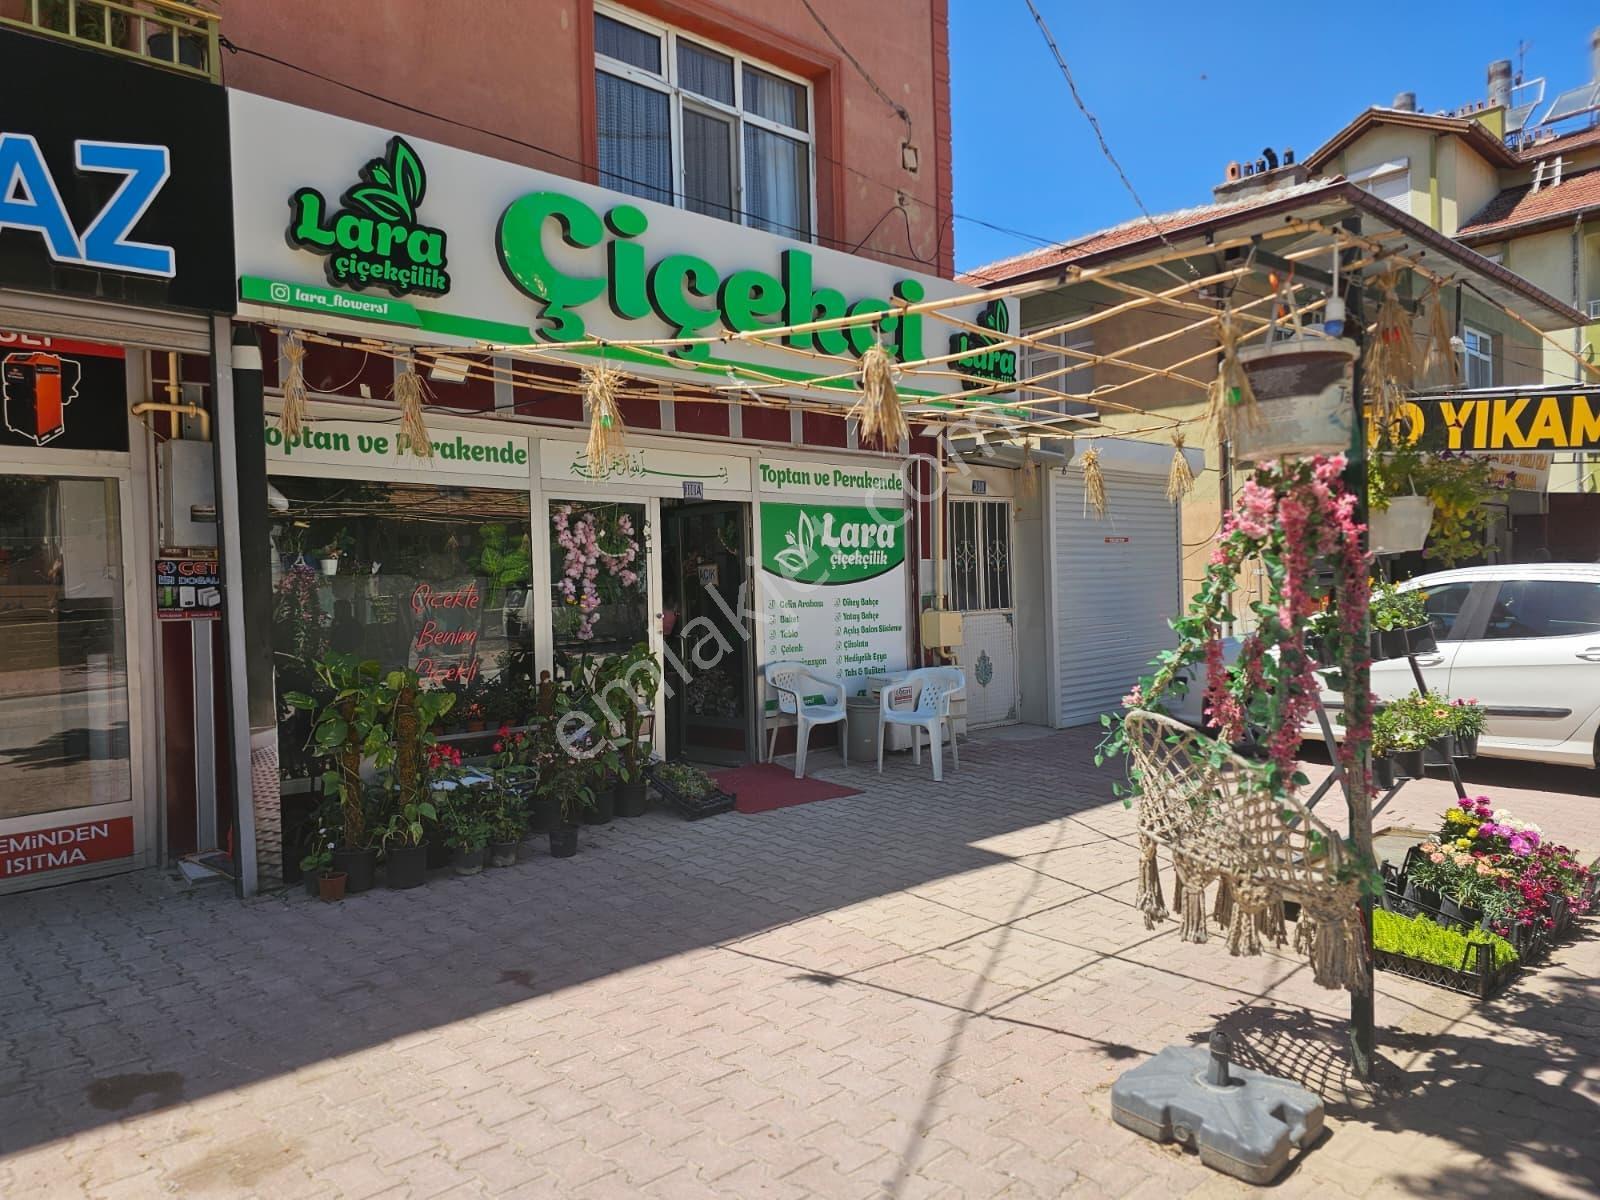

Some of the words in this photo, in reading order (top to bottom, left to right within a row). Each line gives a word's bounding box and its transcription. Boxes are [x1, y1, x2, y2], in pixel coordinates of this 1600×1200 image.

[296, 193, 443, 266] Lara
[335, 253, 446, 290] çiçekçilik
[264, 421, 350, 455] optan
[358, 434, 389, 454] ve
[760, 464, 810, 489] Toptan
[815, 472, 830, 486] ve
[833, 469, 903, 491] Perakende
[821, 512, 896, 549] Lara
[830, 550, 888, 570] çiçekçilik
[7, 848, 86, 874] ISITMA
